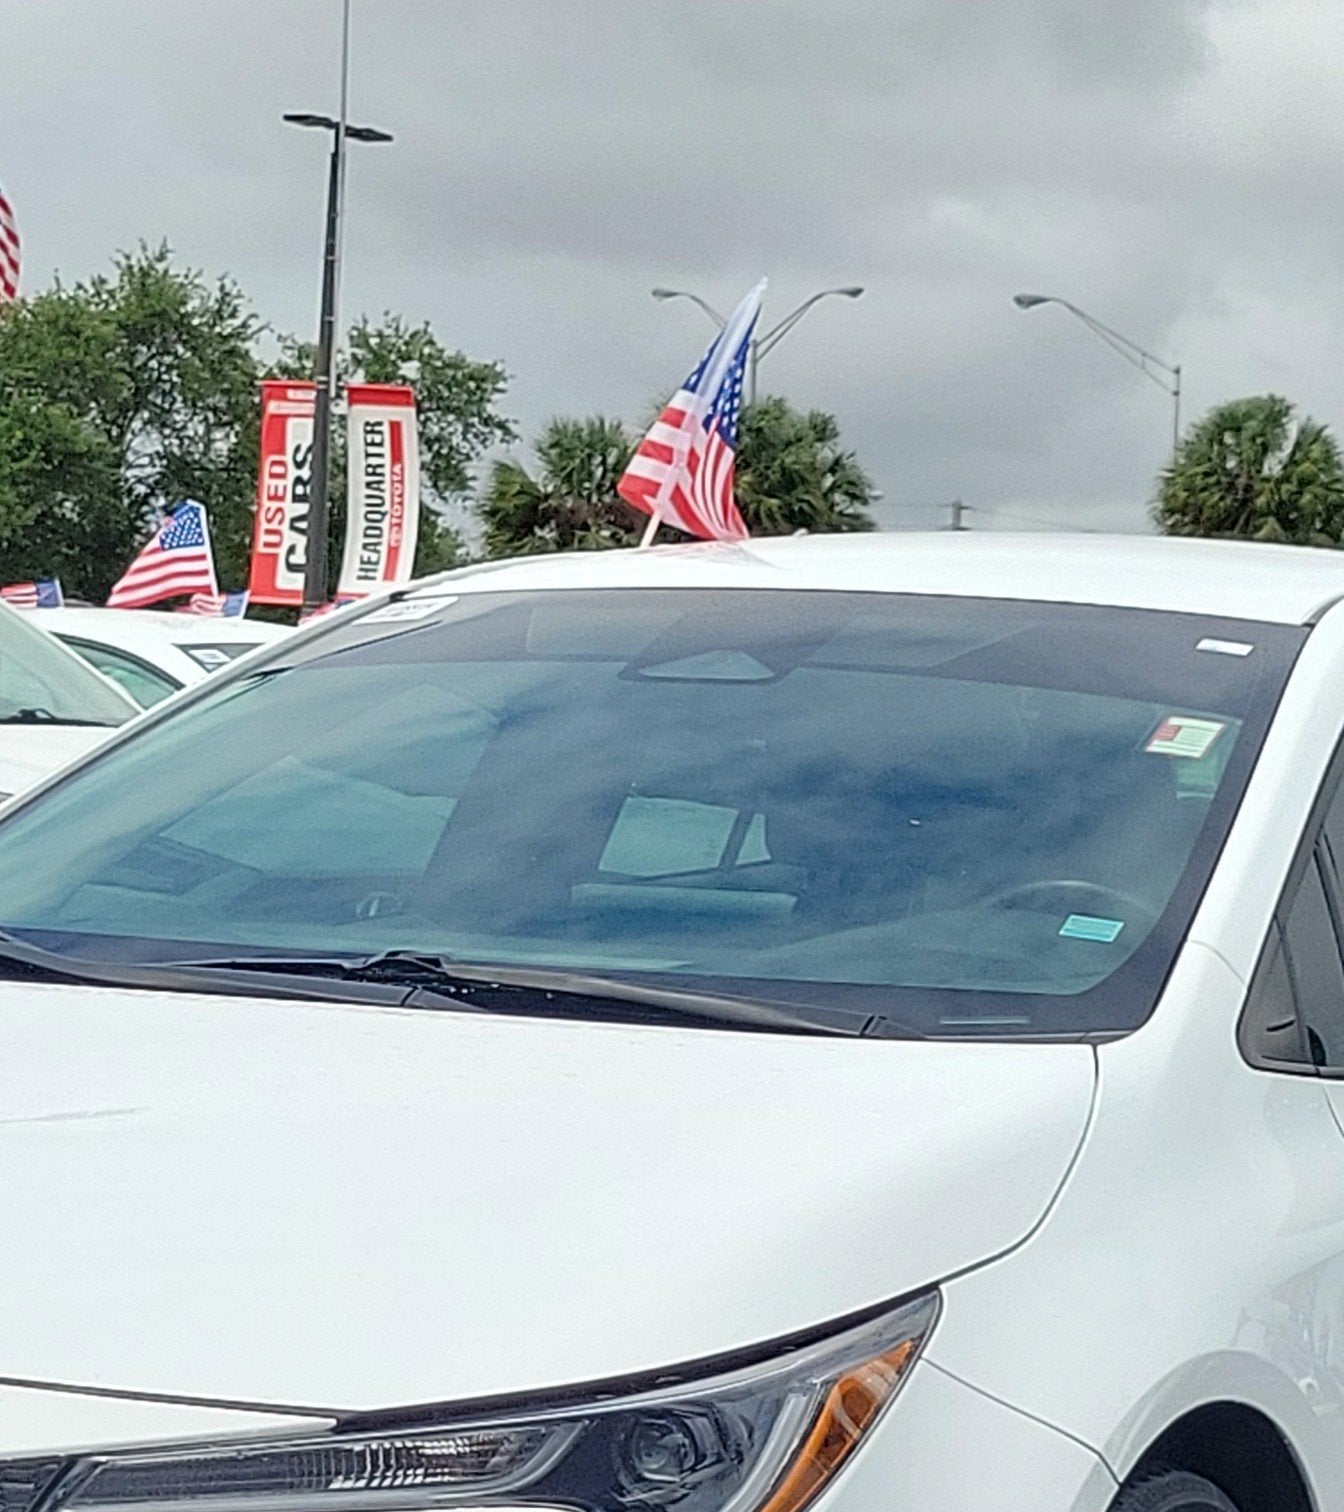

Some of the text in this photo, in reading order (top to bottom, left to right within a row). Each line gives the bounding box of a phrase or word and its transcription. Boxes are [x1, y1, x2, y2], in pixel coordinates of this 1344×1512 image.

[262, 459, 288, 550] USED
[356, 420, 389, 581] HEADQUARTER
[390, 463, 404, 525] TOYOTA
